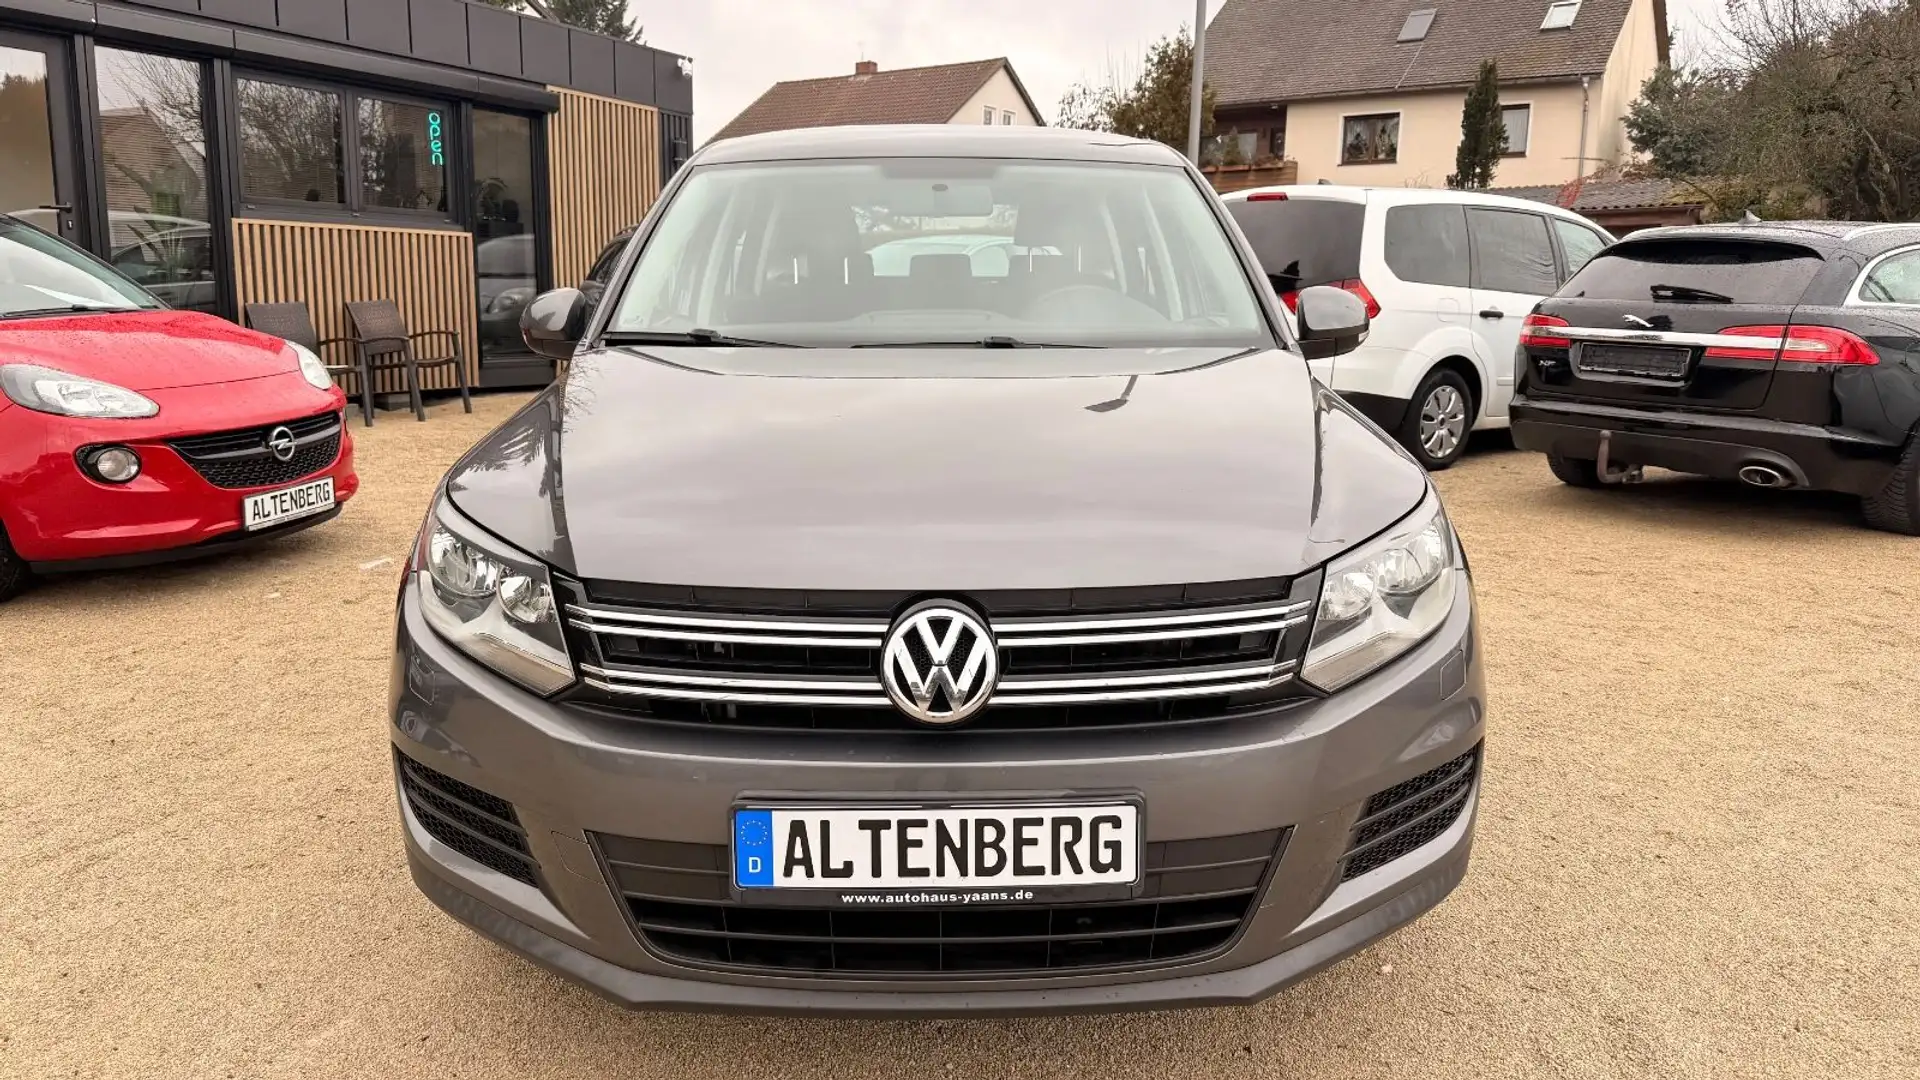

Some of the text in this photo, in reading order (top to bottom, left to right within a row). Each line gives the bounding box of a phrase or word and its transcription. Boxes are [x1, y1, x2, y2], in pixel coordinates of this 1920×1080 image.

[428, 112, 443, 166] open
[253, 482, 330, 521] ALTENBERG
[883, 608, 997, 723] VW
[748, 815, 1122, 878] D ALTENBERG
[841, 889, 1034, 904] www.autohaus-yaans.de
